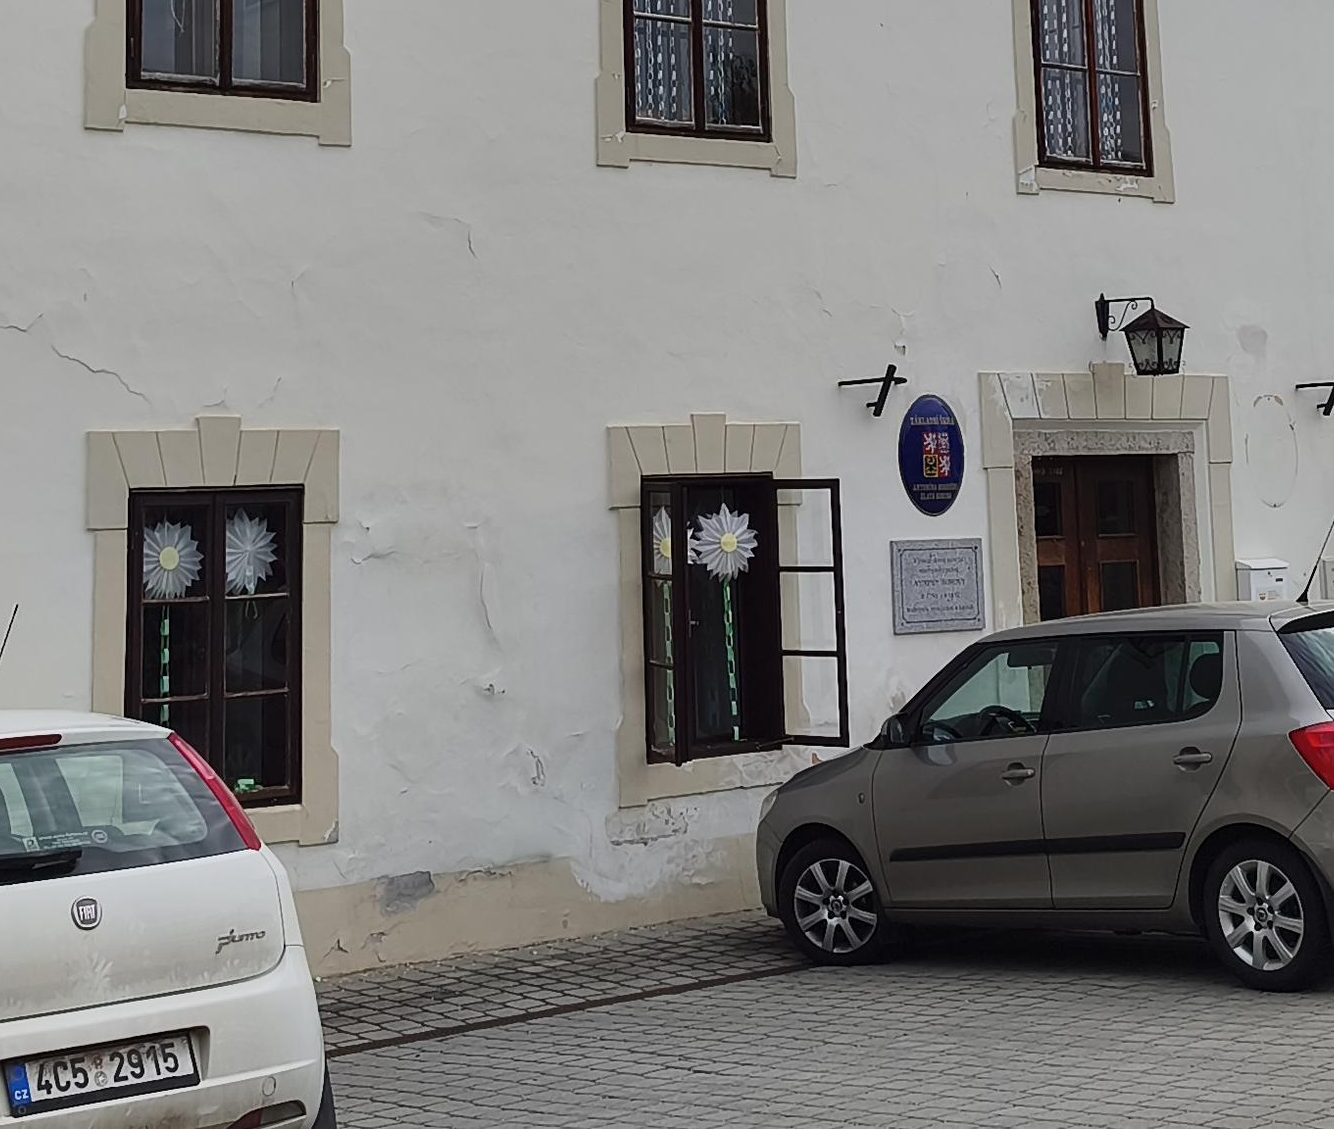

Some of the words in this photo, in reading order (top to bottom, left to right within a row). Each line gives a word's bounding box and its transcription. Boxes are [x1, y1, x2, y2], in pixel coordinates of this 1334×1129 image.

[78, 904, 96, 921] FIAT
[37, 1057, 90, 1095] 4C5
[109, 1042, 180, 1083] 2915
[14, 1088, 29, 1101] CZ
